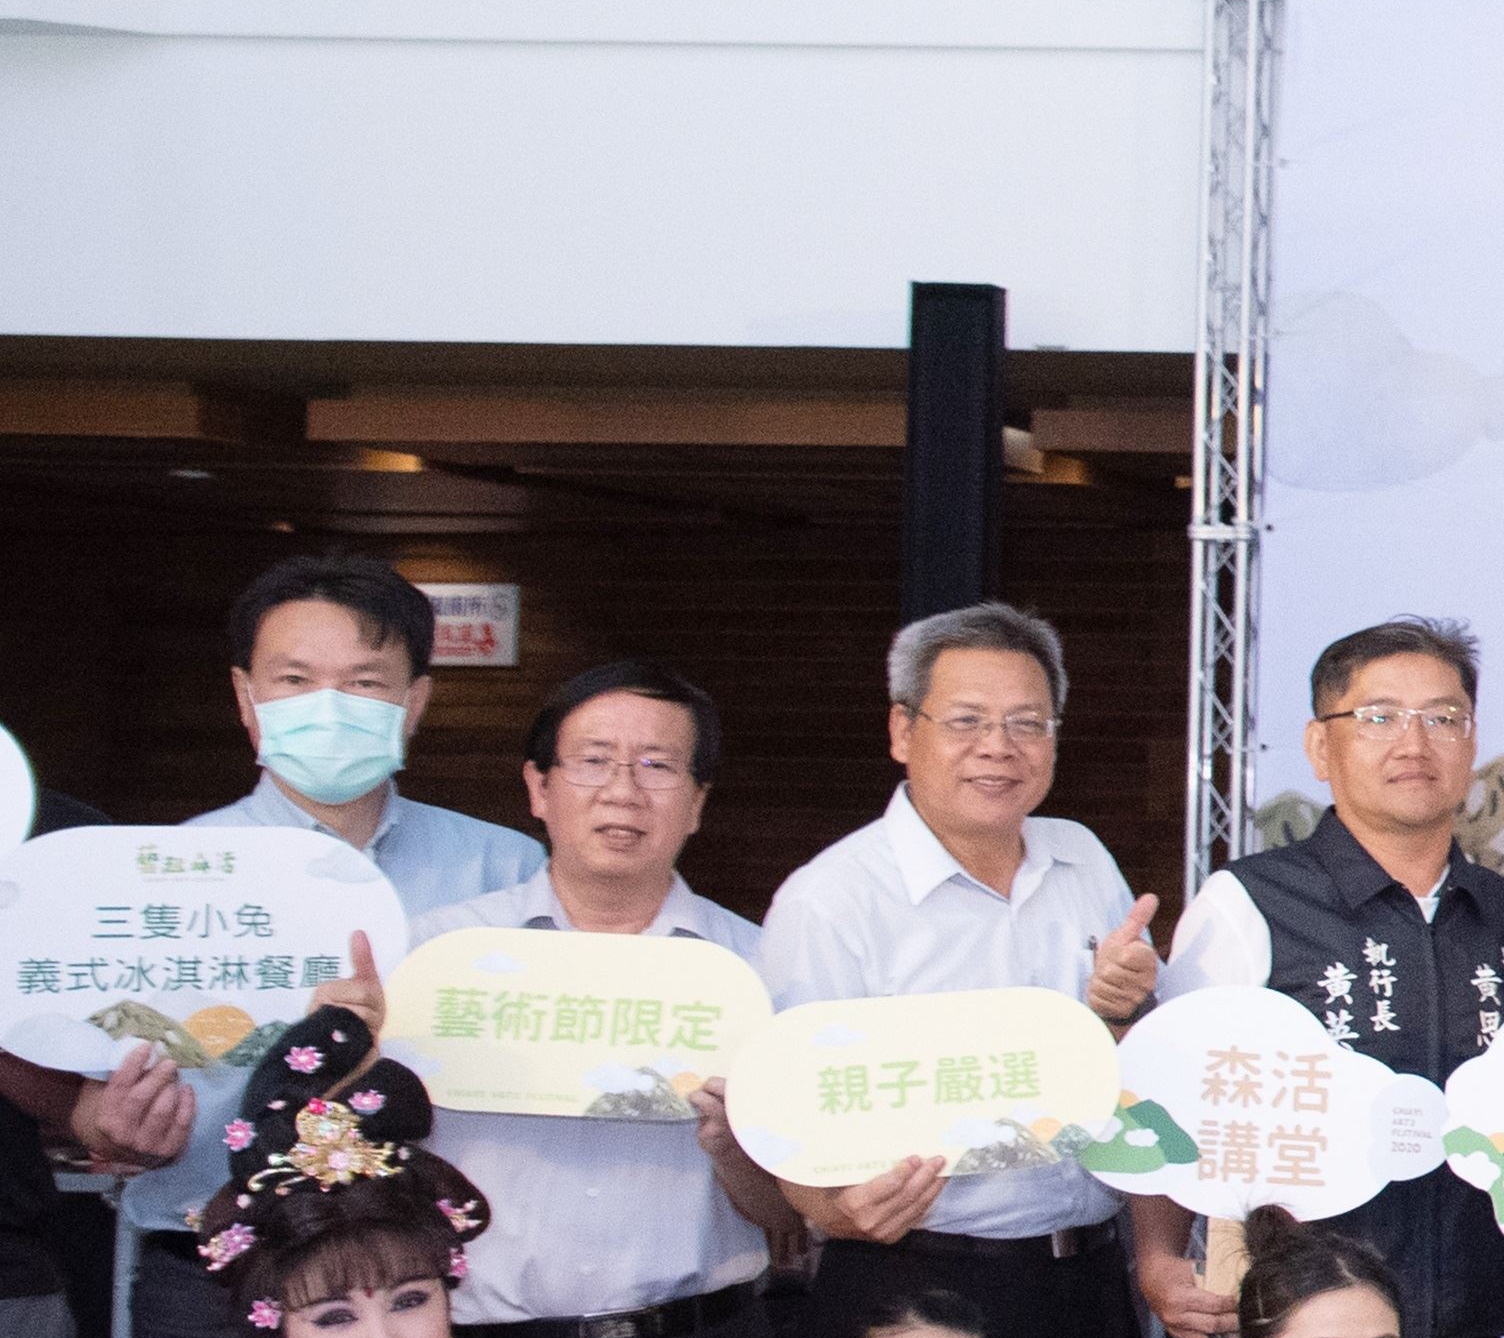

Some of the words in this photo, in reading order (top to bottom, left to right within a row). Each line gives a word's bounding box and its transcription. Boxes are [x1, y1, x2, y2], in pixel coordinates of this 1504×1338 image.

[92, 902, 274, 940] 三隻小兔
[432, 987, 723, 1052] 藝術節限定
[817, 1050, 1041, 1115] 親子嚴選
[1201, 1045, 1332, 1114] 森活
[1197, 1118, 1328, 1187] 講堂
[1391, 1141, 1422, 1154] 2020
